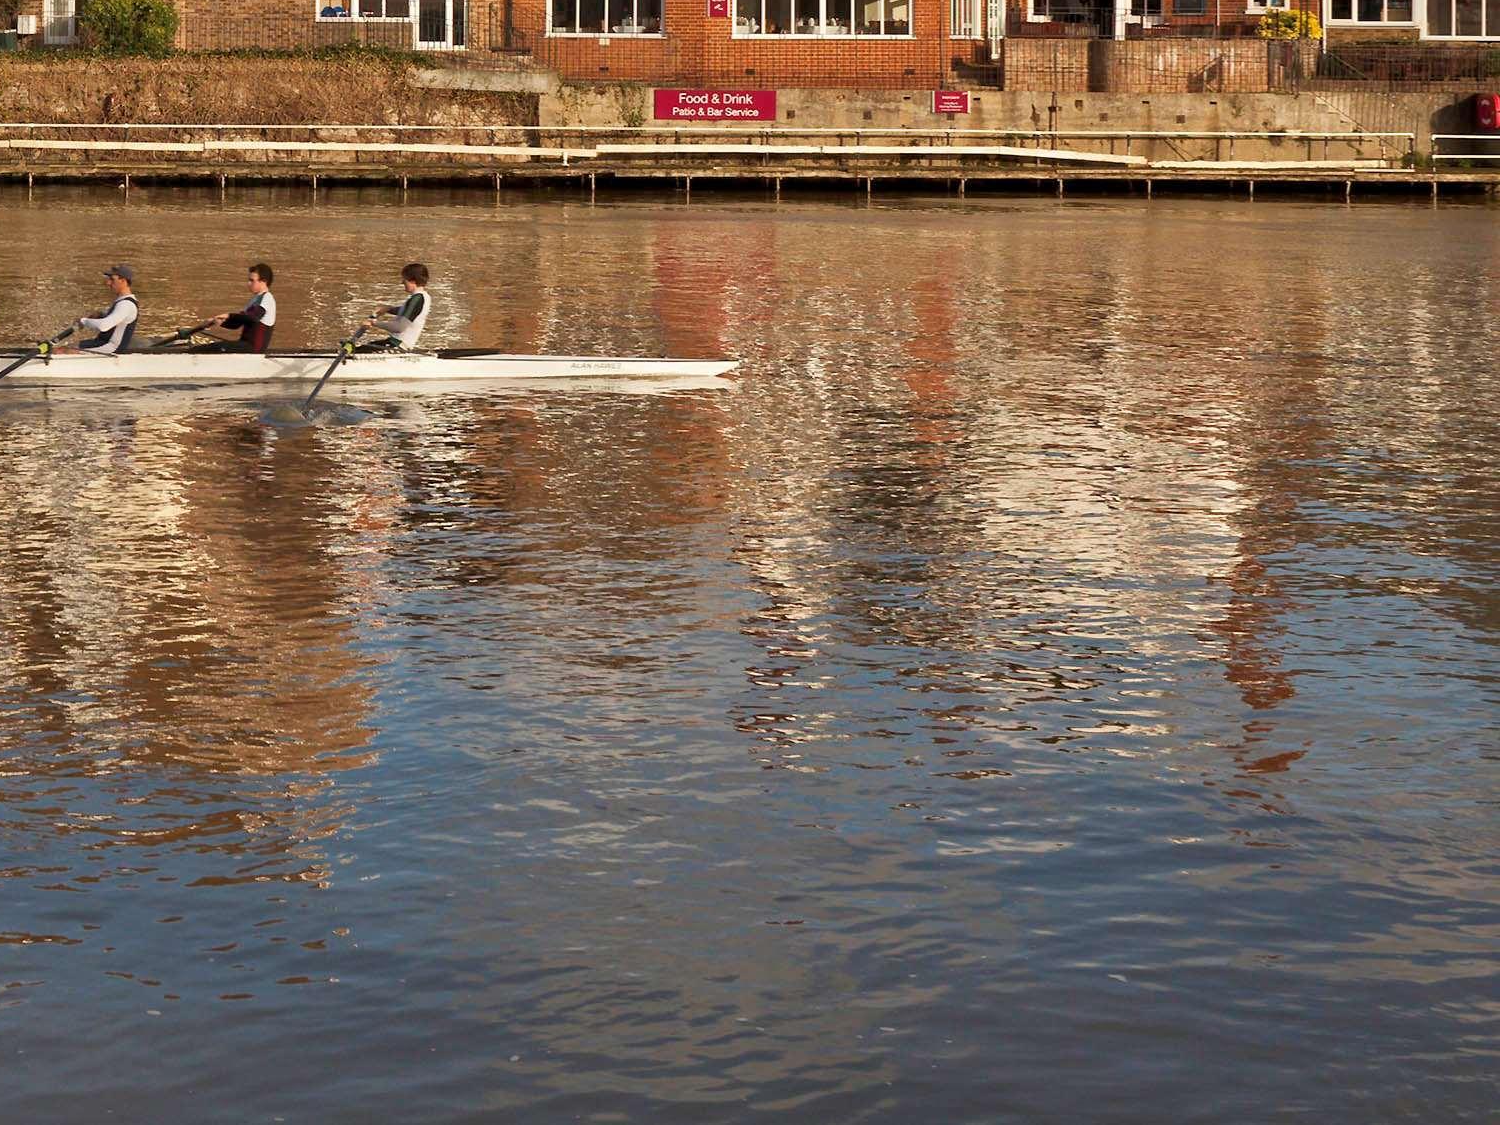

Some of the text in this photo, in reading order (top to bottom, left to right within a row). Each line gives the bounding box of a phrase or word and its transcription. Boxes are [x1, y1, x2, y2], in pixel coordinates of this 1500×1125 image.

[678, 92, 753, 105] Food & Drink
[672, 106, 760, 117] Patio & Bar Service
